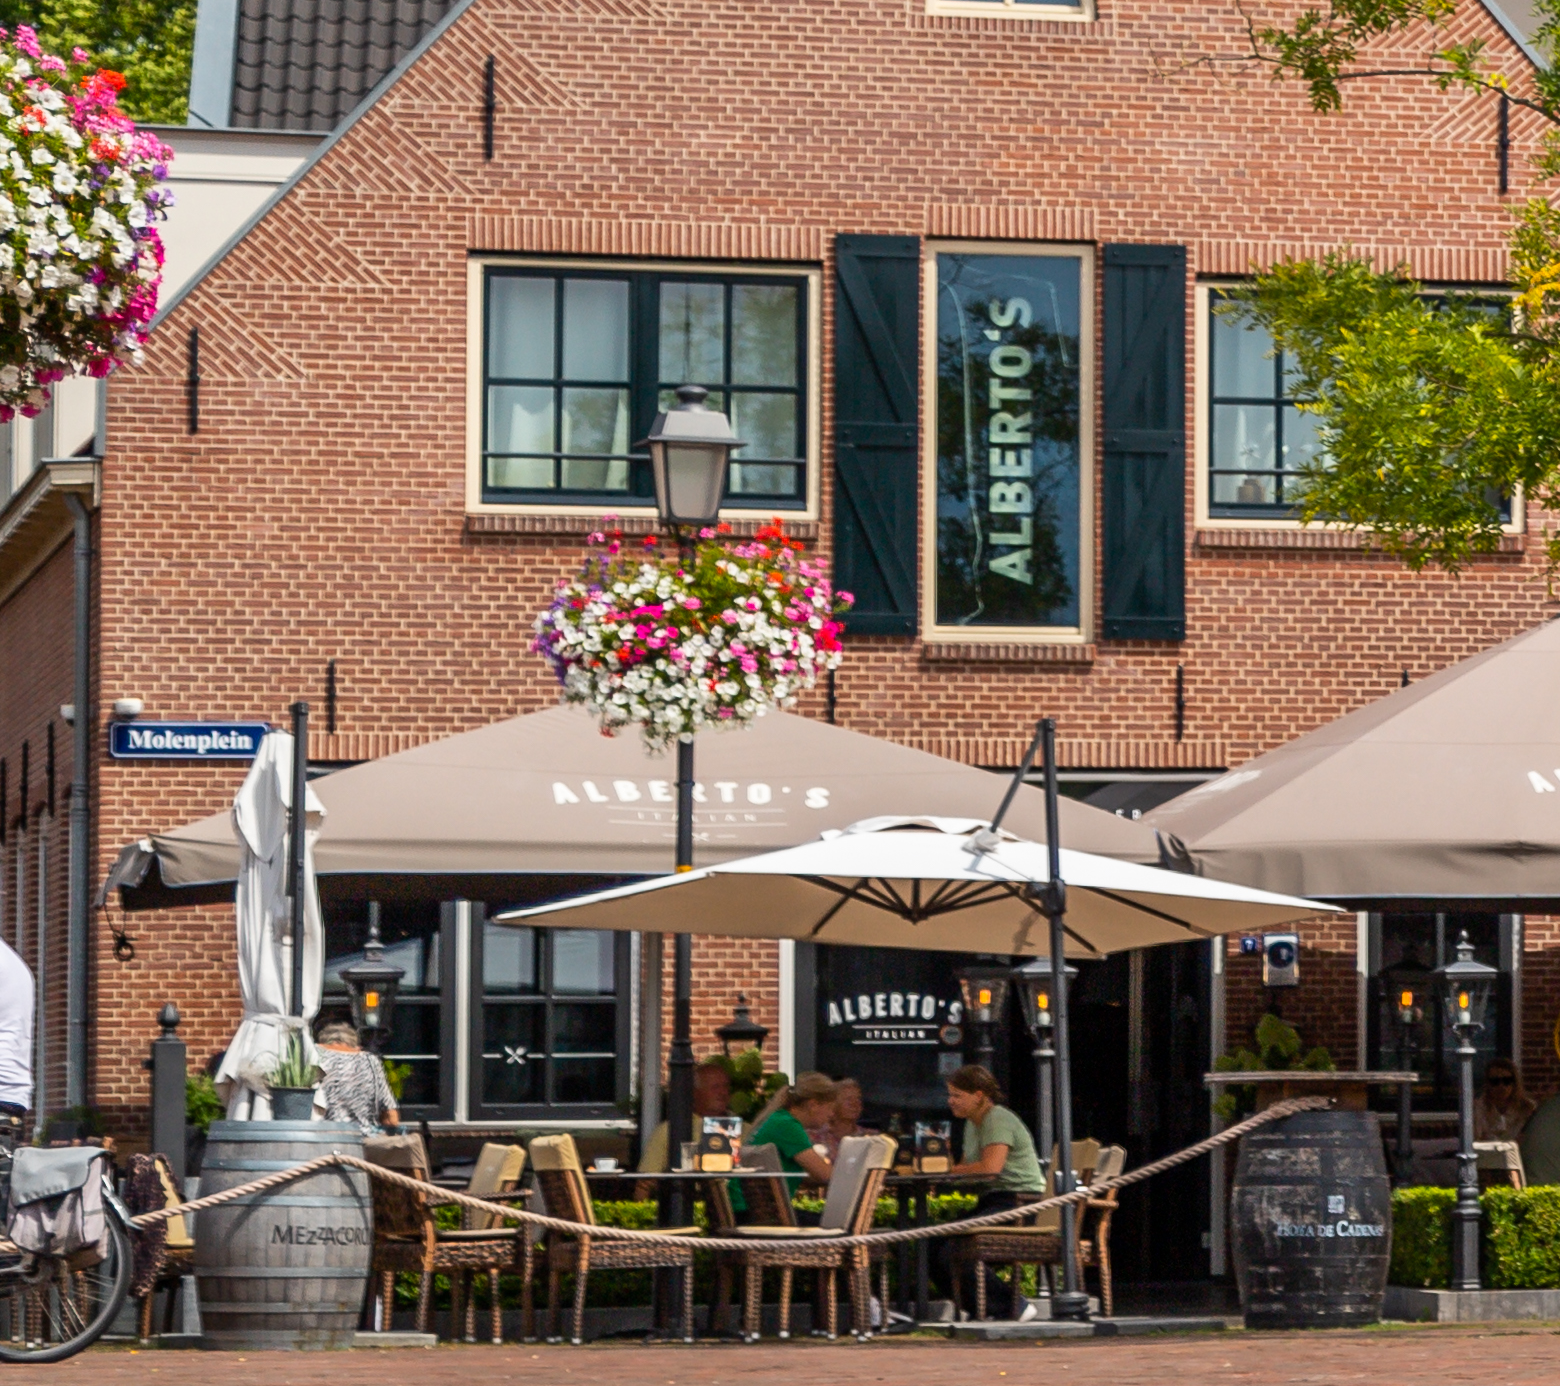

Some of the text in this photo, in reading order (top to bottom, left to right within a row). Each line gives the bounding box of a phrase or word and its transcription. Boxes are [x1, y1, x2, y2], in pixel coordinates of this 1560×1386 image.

[983, 296, 1034, 585] ALBERTO'S
[128, 729, 253, 755] Molenplein
[552, 780, 830, 809] ALBERTO'S
[828, 992, 963, 1027] ALBERTO'S
[866, 1030, 926, 1039] ITALIAN
